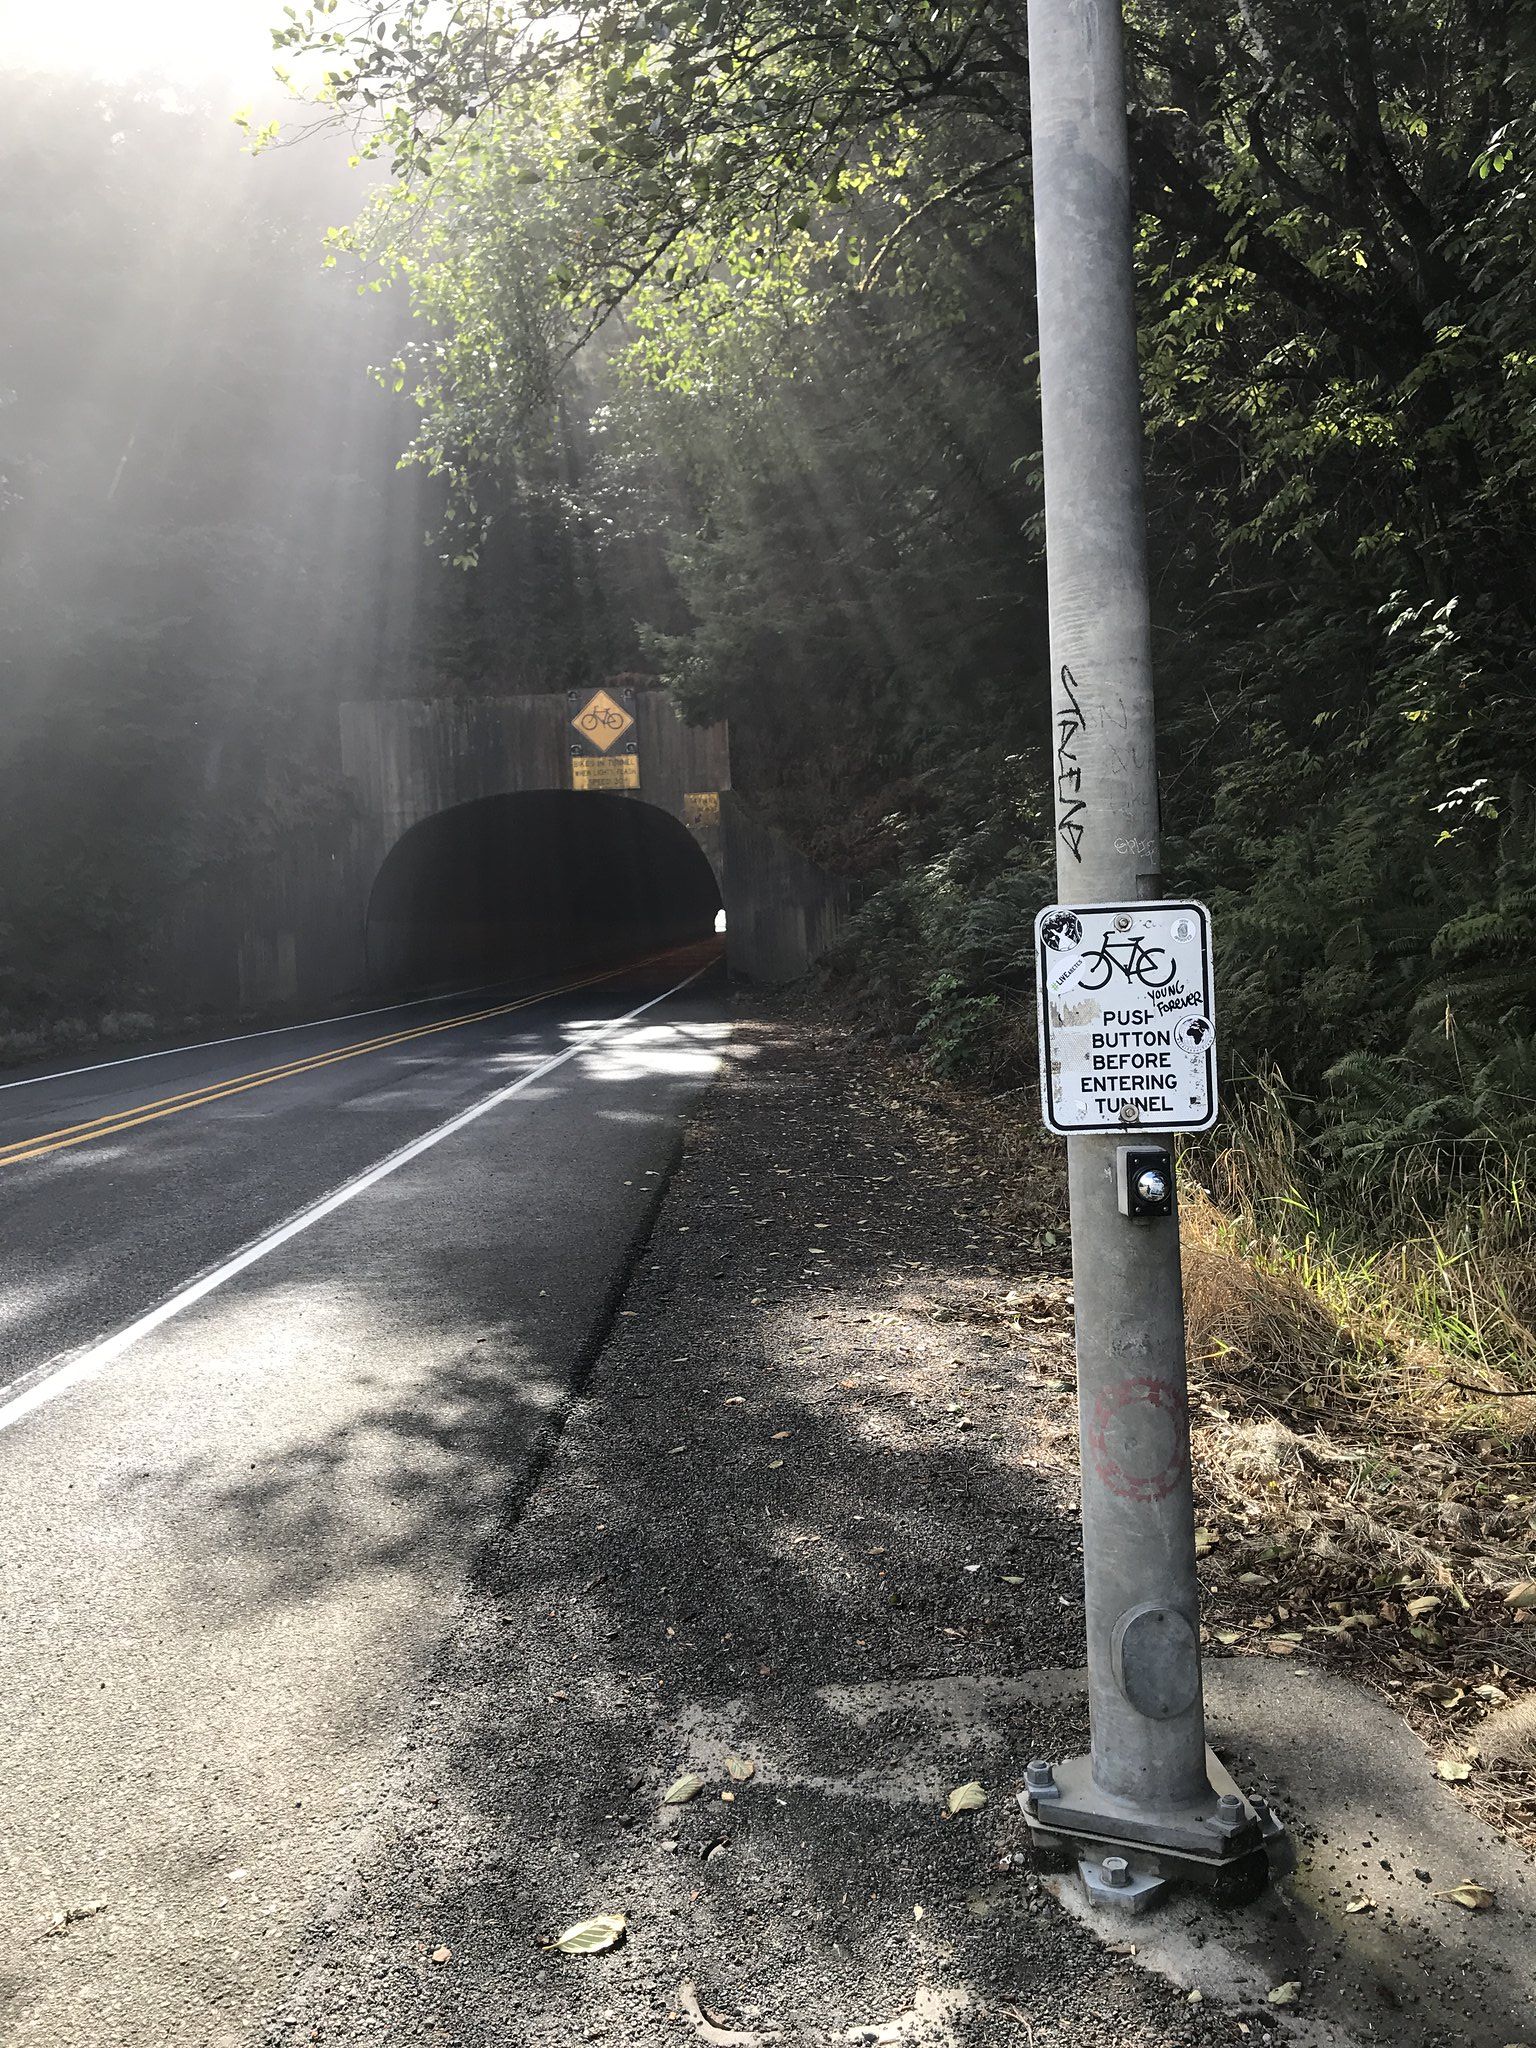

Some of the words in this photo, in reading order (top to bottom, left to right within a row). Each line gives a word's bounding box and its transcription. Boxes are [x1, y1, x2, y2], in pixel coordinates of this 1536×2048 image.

[1147, 980, 1184, 1007] YOUNG
[1092, 1030, 1171, 1048] BUTTON
[1093, 1052, 1171, 1070] BEFORE
[1081, 1073, 1178, 1092] ENTERING
